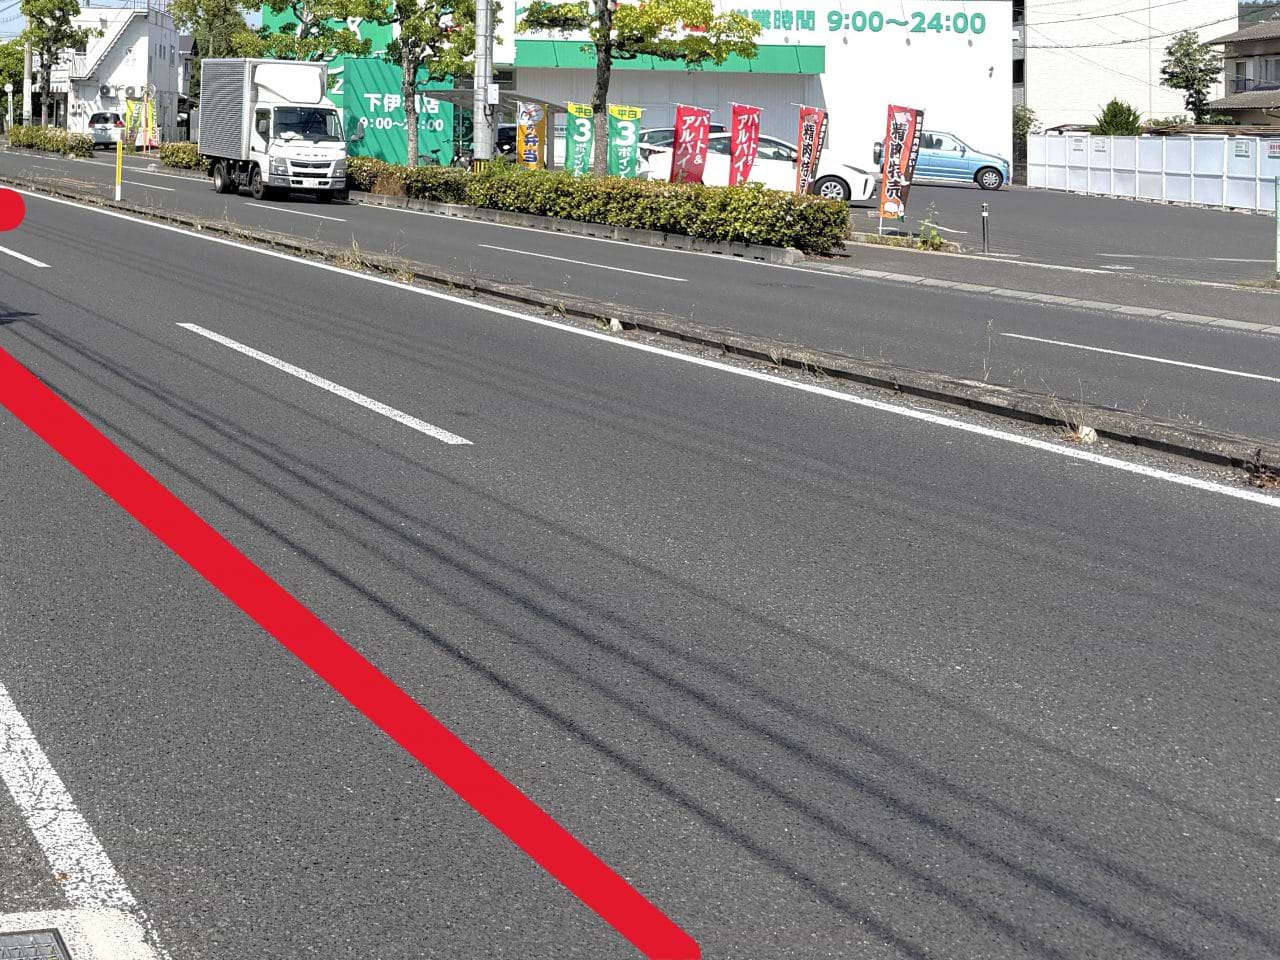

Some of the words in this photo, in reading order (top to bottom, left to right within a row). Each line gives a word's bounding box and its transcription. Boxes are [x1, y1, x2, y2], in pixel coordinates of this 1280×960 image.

[363, 93, 440, 114] 下伊店
[575, 107, 593, 117] 平日
[617, 109, 638, 119] 平日
[886, 121, 909, 199] 精肉特売
